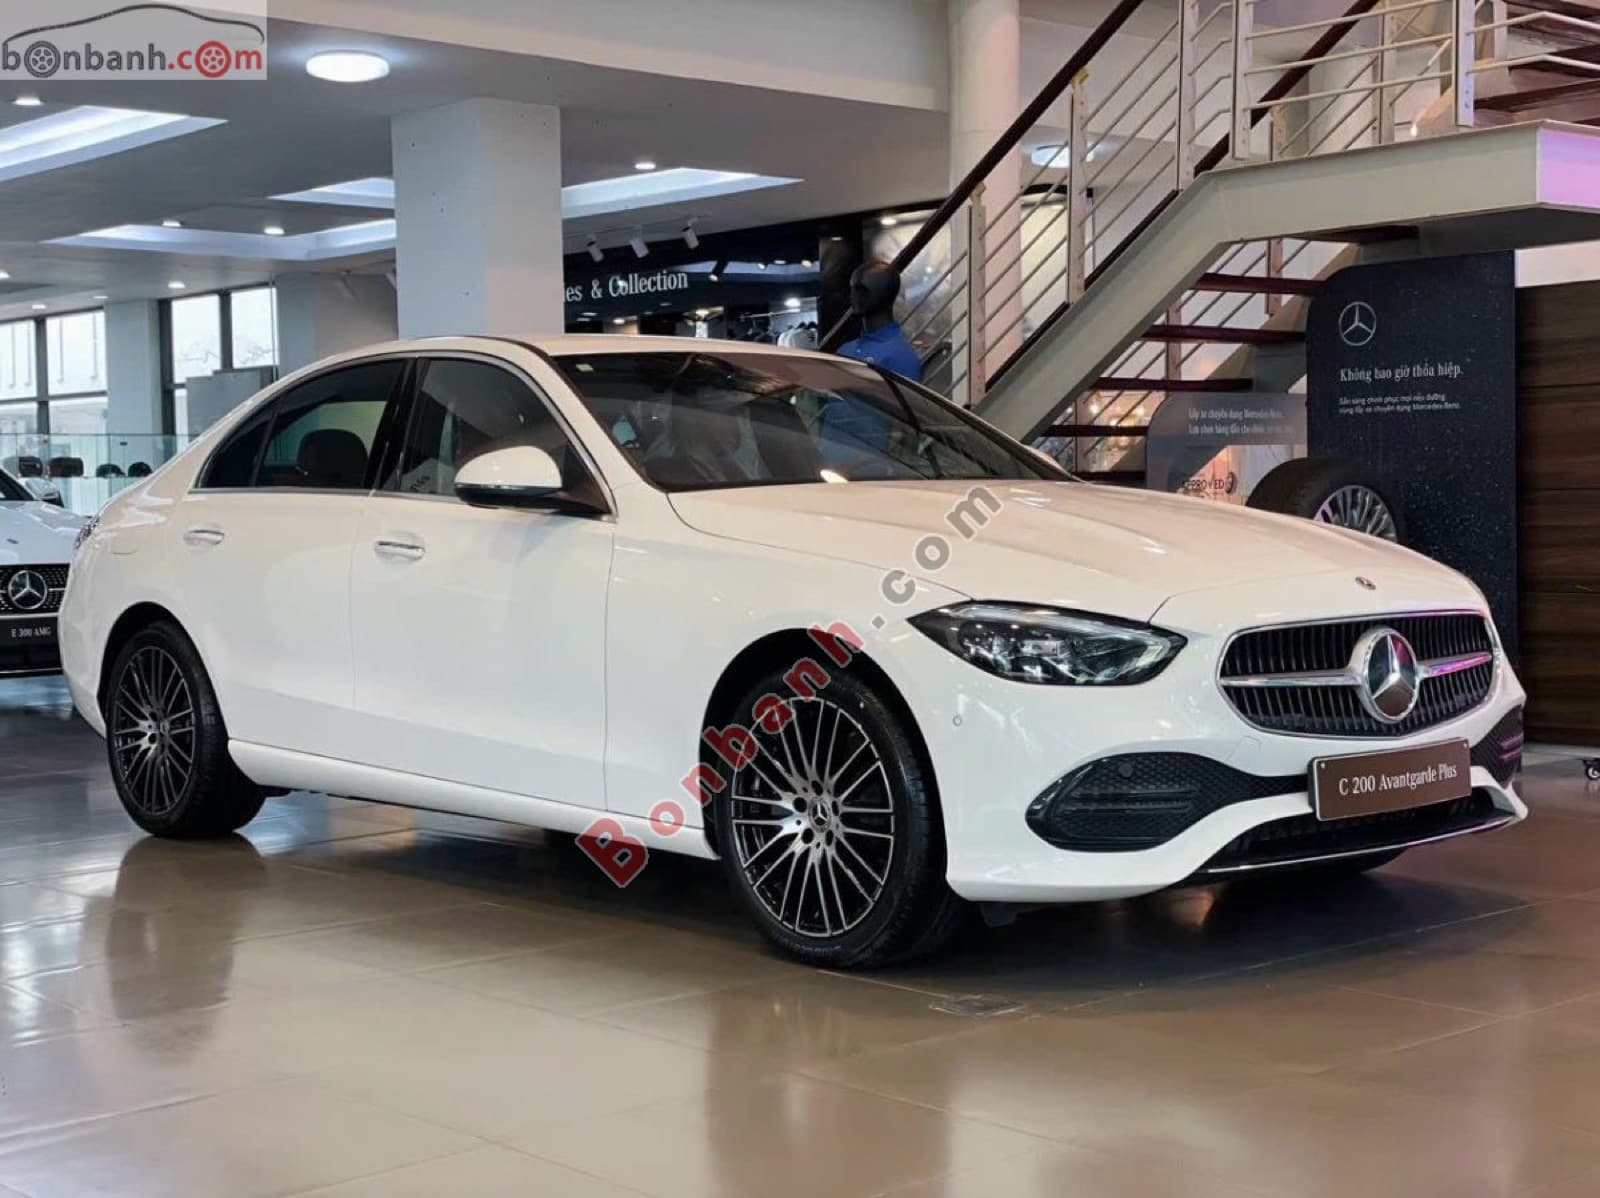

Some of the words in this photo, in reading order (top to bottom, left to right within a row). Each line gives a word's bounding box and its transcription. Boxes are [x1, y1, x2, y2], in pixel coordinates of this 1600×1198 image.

[564, 285, 583, 302] es
[591, 278, 603, 299] &
[608, 269, 689, 297] Collection
[1340, 366, 1372, 383] Không
[1394, 364, 1410, 382] giờ
[10, 628, 17, 638] E
[1339, 777, 1349, 796] C
[1352, 774, 1376, 794] 200
[1378, 764, 1437, 790] Avantgarde
[1438, 761, 1457, 781] Plus
